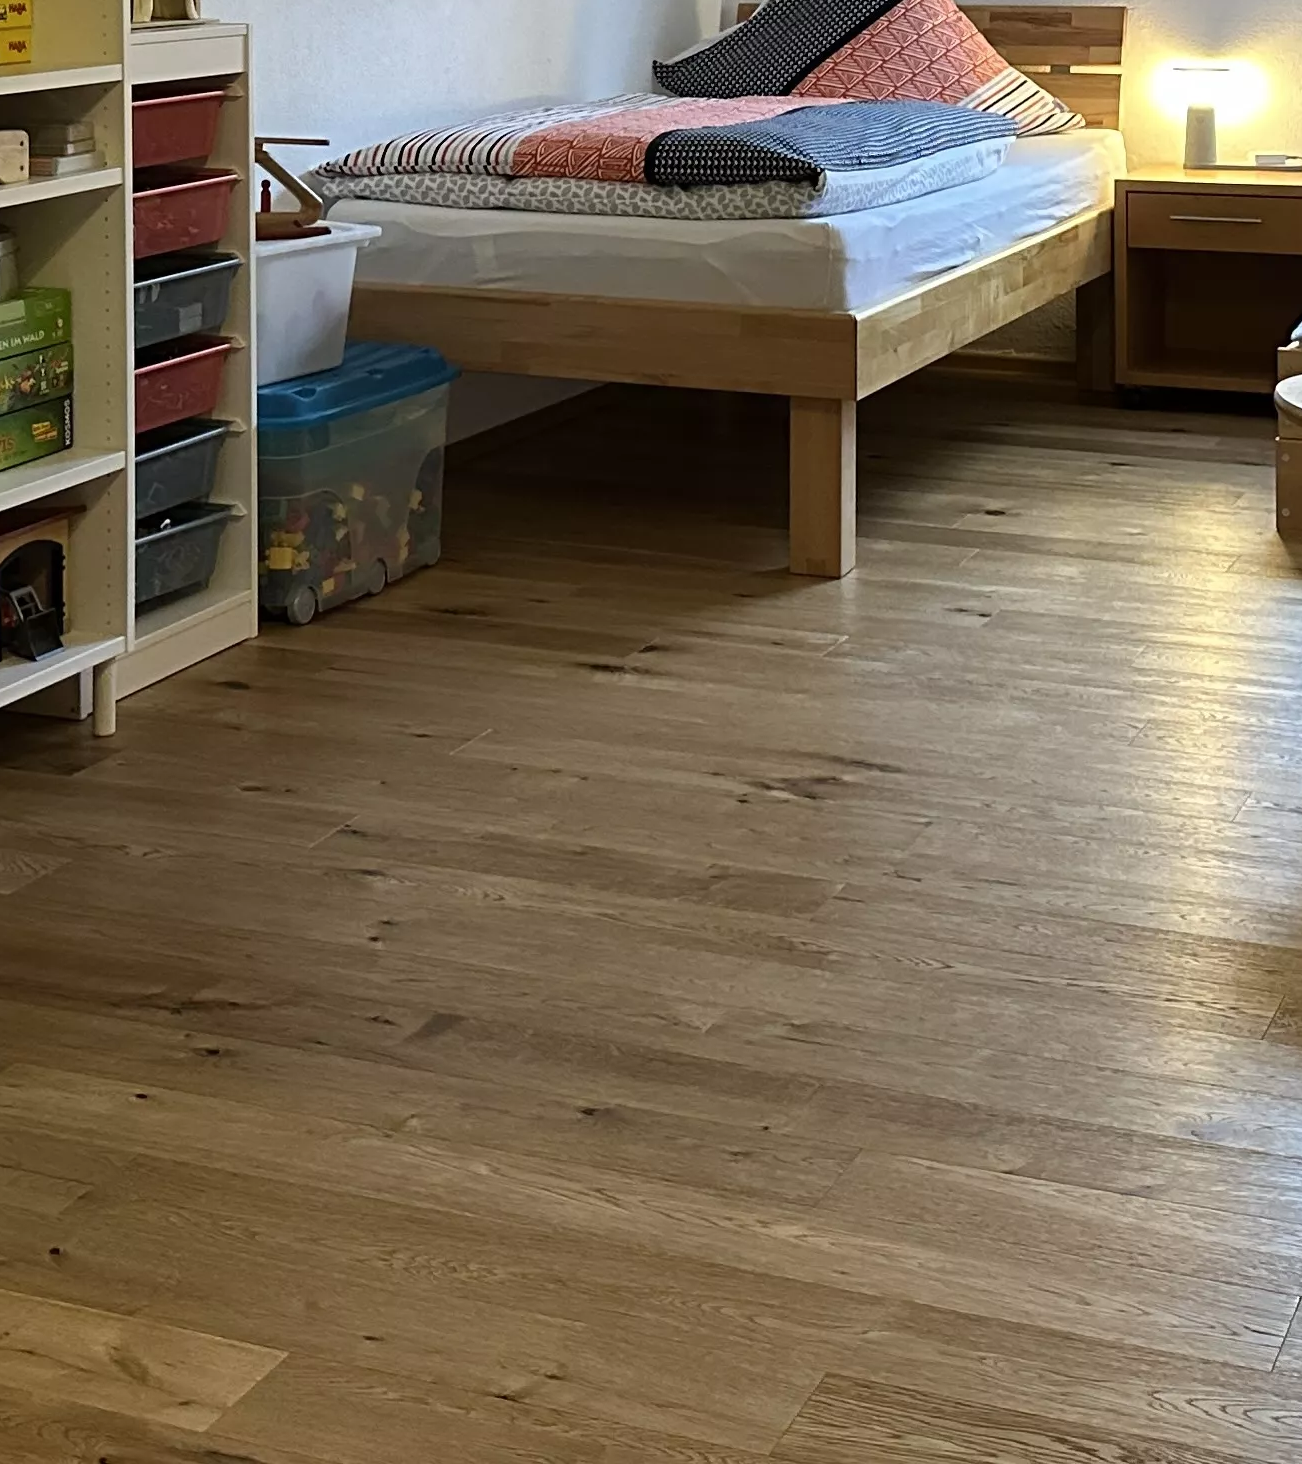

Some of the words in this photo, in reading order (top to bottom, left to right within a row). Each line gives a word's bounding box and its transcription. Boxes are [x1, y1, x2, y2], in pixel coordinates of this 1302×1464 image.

[8, 2, 27, 16] HABA
[8, 40, 27, 54] HABA
[10, 336, 23, 349] IM
[23, 330, 45, 344] WALD
[63, 398, 72, 447] KOSMOS
